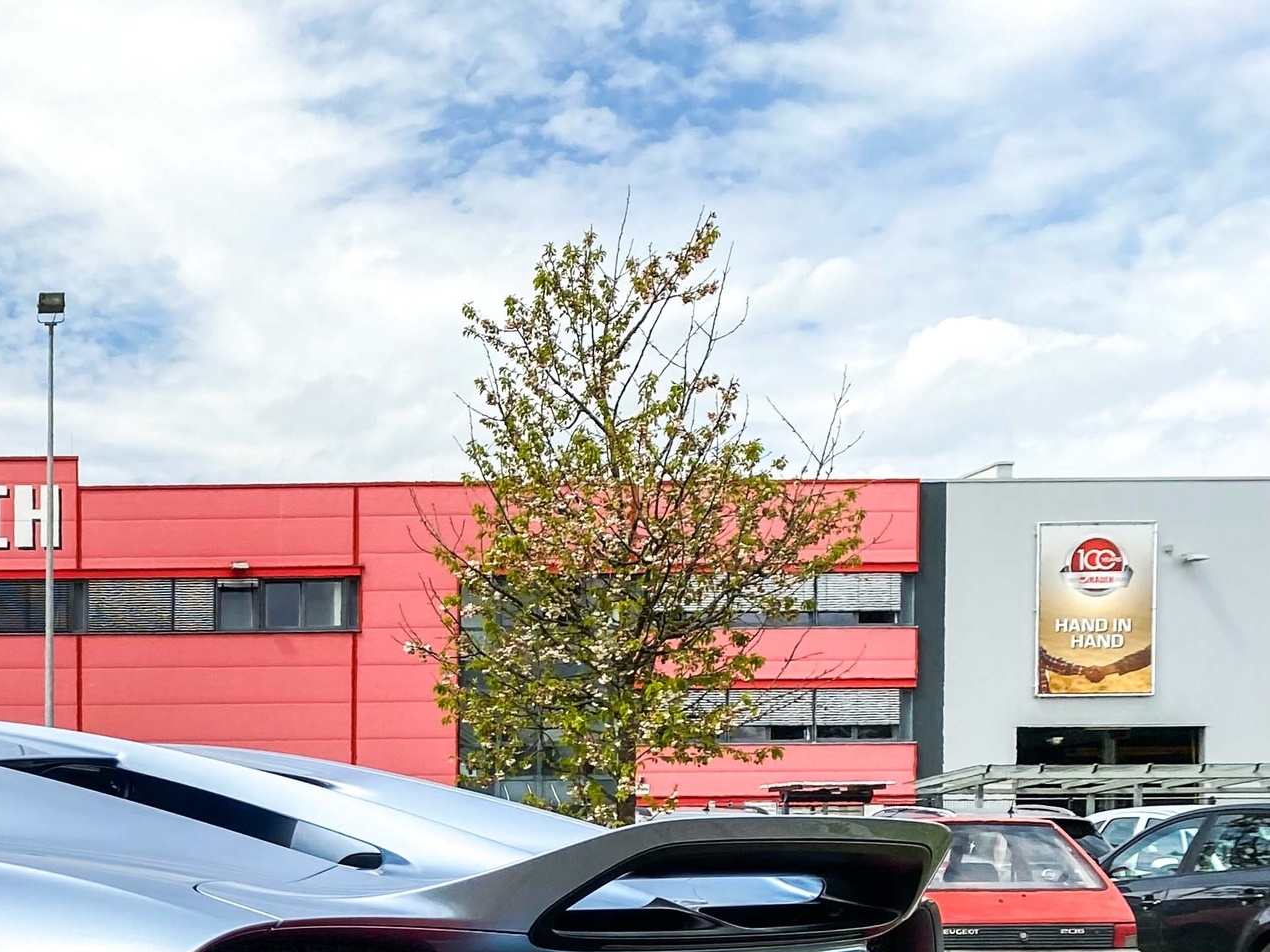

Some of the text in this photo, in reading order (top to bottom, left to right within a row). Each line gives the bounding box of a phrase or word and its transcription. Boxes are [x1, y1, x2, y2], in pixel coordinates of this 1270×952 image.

[1055, 617, 1132, 633] HAND IN
[1071, 634, 1125, 649] HAND
[943, 928, 980, 936] EUGEOT
